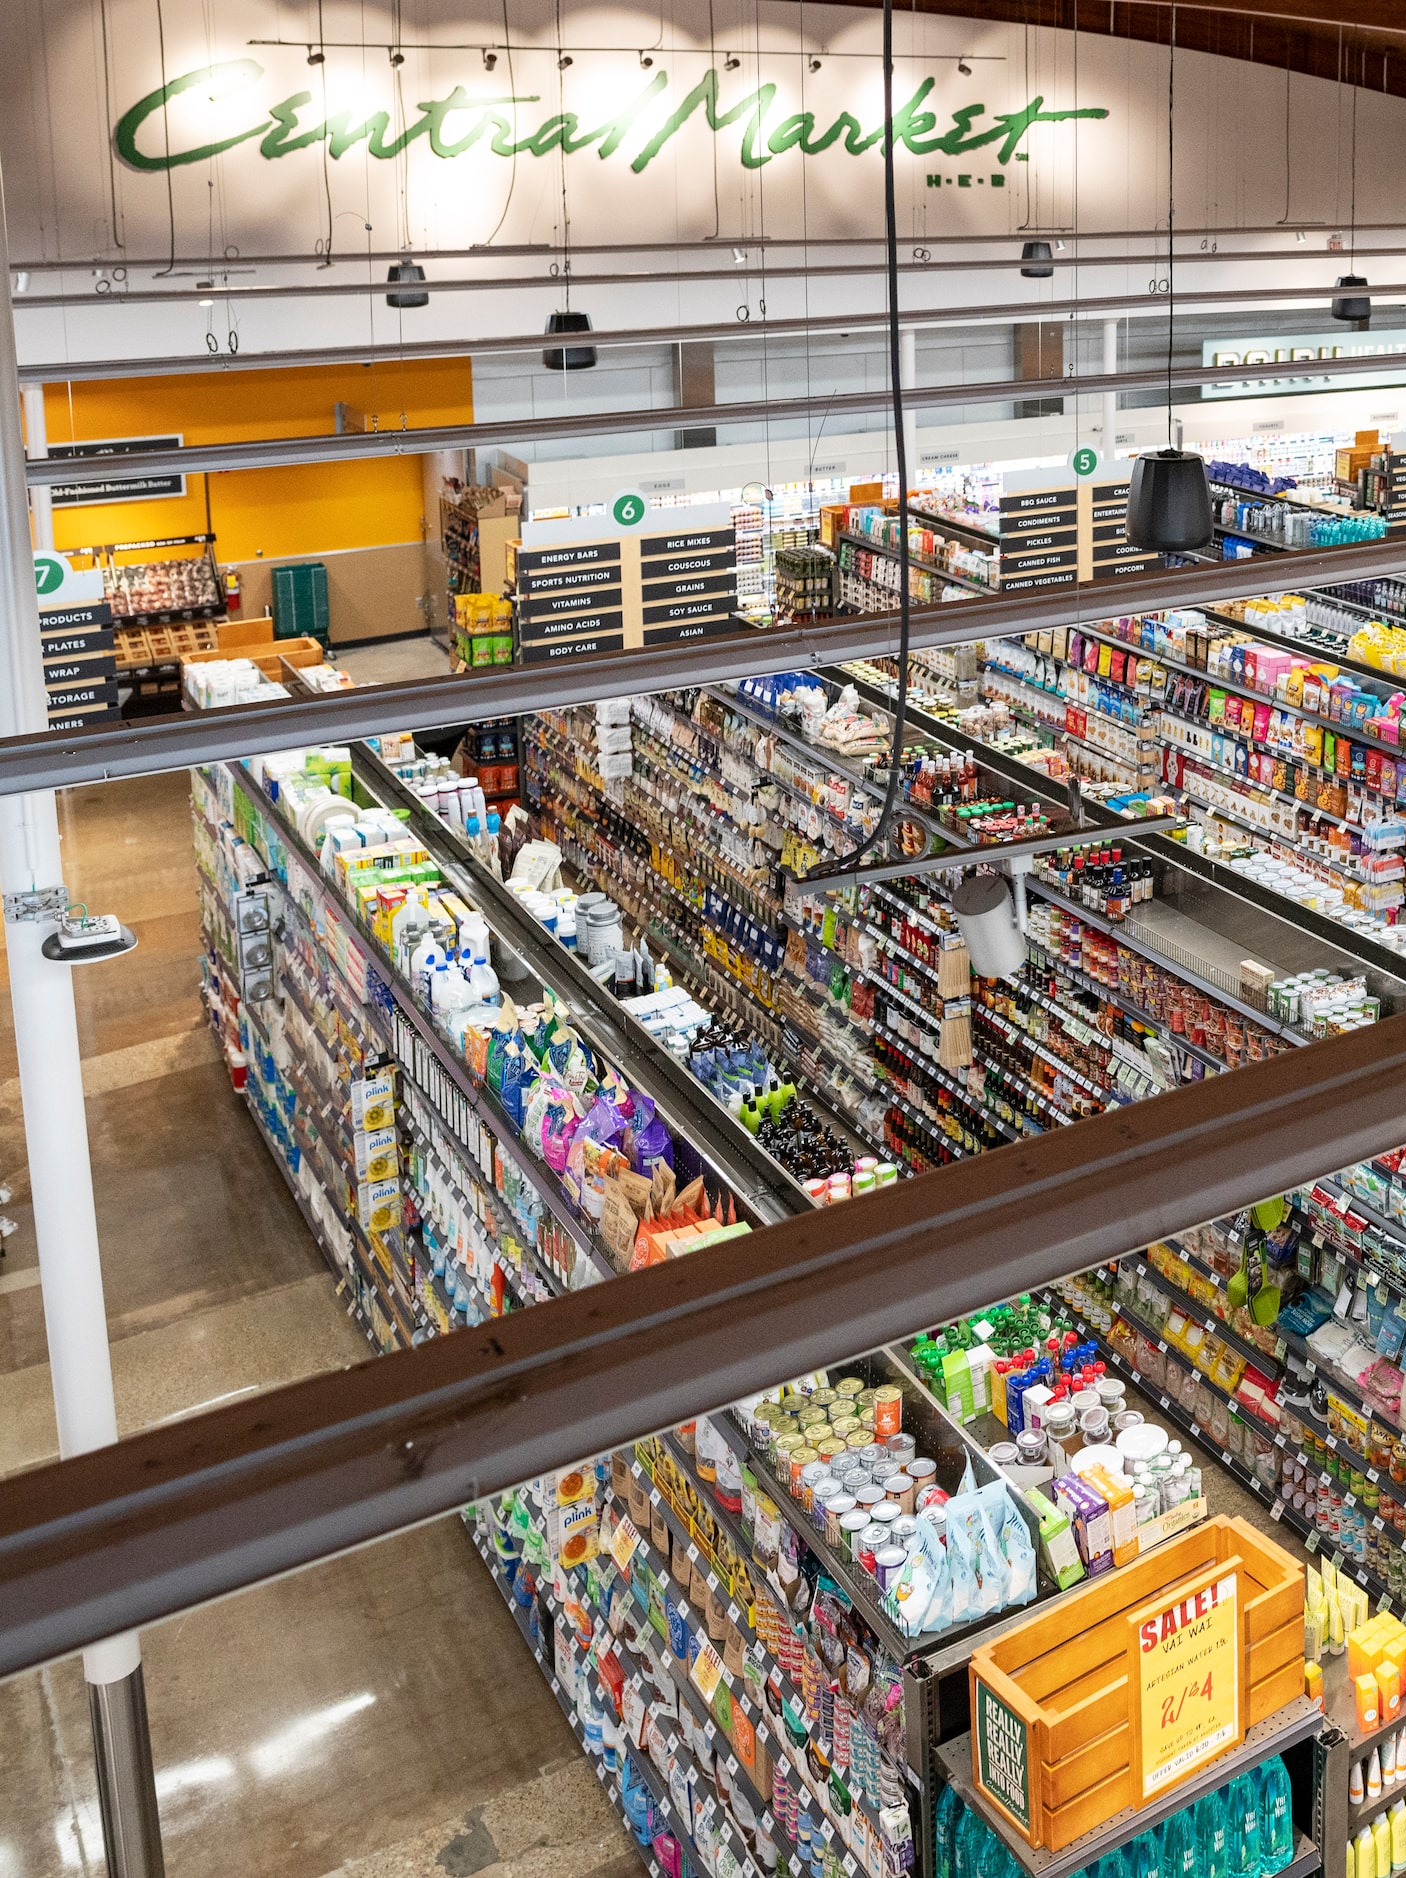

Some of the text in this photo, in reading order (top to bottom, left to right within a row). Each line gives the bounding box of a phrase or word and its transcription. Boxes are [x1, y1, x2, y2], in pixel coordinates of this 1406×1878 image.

[115, 58, 1109, 173] Central Market
[1080, 454, 1090, 471] 5
[106, 481, 147, 492] Buttermilk
[1020, 496, 1057, 507] BBQ SAUCE
[622, 501, 635, 520] 6
[1018, 516, 1061, 528] CONDIMENTS
[667, 536, 711, 549] RICE MIXES
[1027, 536, 1052, 546] PICKLES
[541, 549, 598, 564] ENERGY BARS
[1018, 555, 1061, 568] CANNED FISH
[668, 559, 711, 572] COUSCOUS
[1115, 564, 1145, 574] POPCORN
[38, 565, 51, 588] 7
[531, 571, 610, 589] SPORTS NUTRITION
[1006, 573, 1073, 590] CANNED VEGETABLES
[676, 582, 705, 593] GRAINS
[552, 597, 592, 609] VITAMINS
[669, 603, 713, 617] SOY SAUCE
[544, 619, 601, 634] AMINO ACIDS
[679, 627, 704, 638] ASIAN
[48, 639, 86, 653] PLATES
[550, 642, 597, 657] BODY CARE
[49, 666, 80, 679] WRAP
[366, 1084, 388, 1099] plink
[370, 1136, 392, 1150] plink
[372, 1186, 396, 1201] plink
[563, 1506, 592, 1528] plink
[1162, 1511, 1190, 1533] Organics
[621, 1518, 638, 1543] SALE!
[1140, 1581, 1219, 1654] SALE!
[1162, 1616, 1213, 1654] VAI WAI
[703, 1641, 723, 1672] SALE!
[985, 1694, 1023, 1748] REALLY,
[986, 1716, 1023, 1767] REALLY,
[986, 1738, 1023, 1787] REALLY
[989, 1762, 1025, 1810] INTO FOOD
